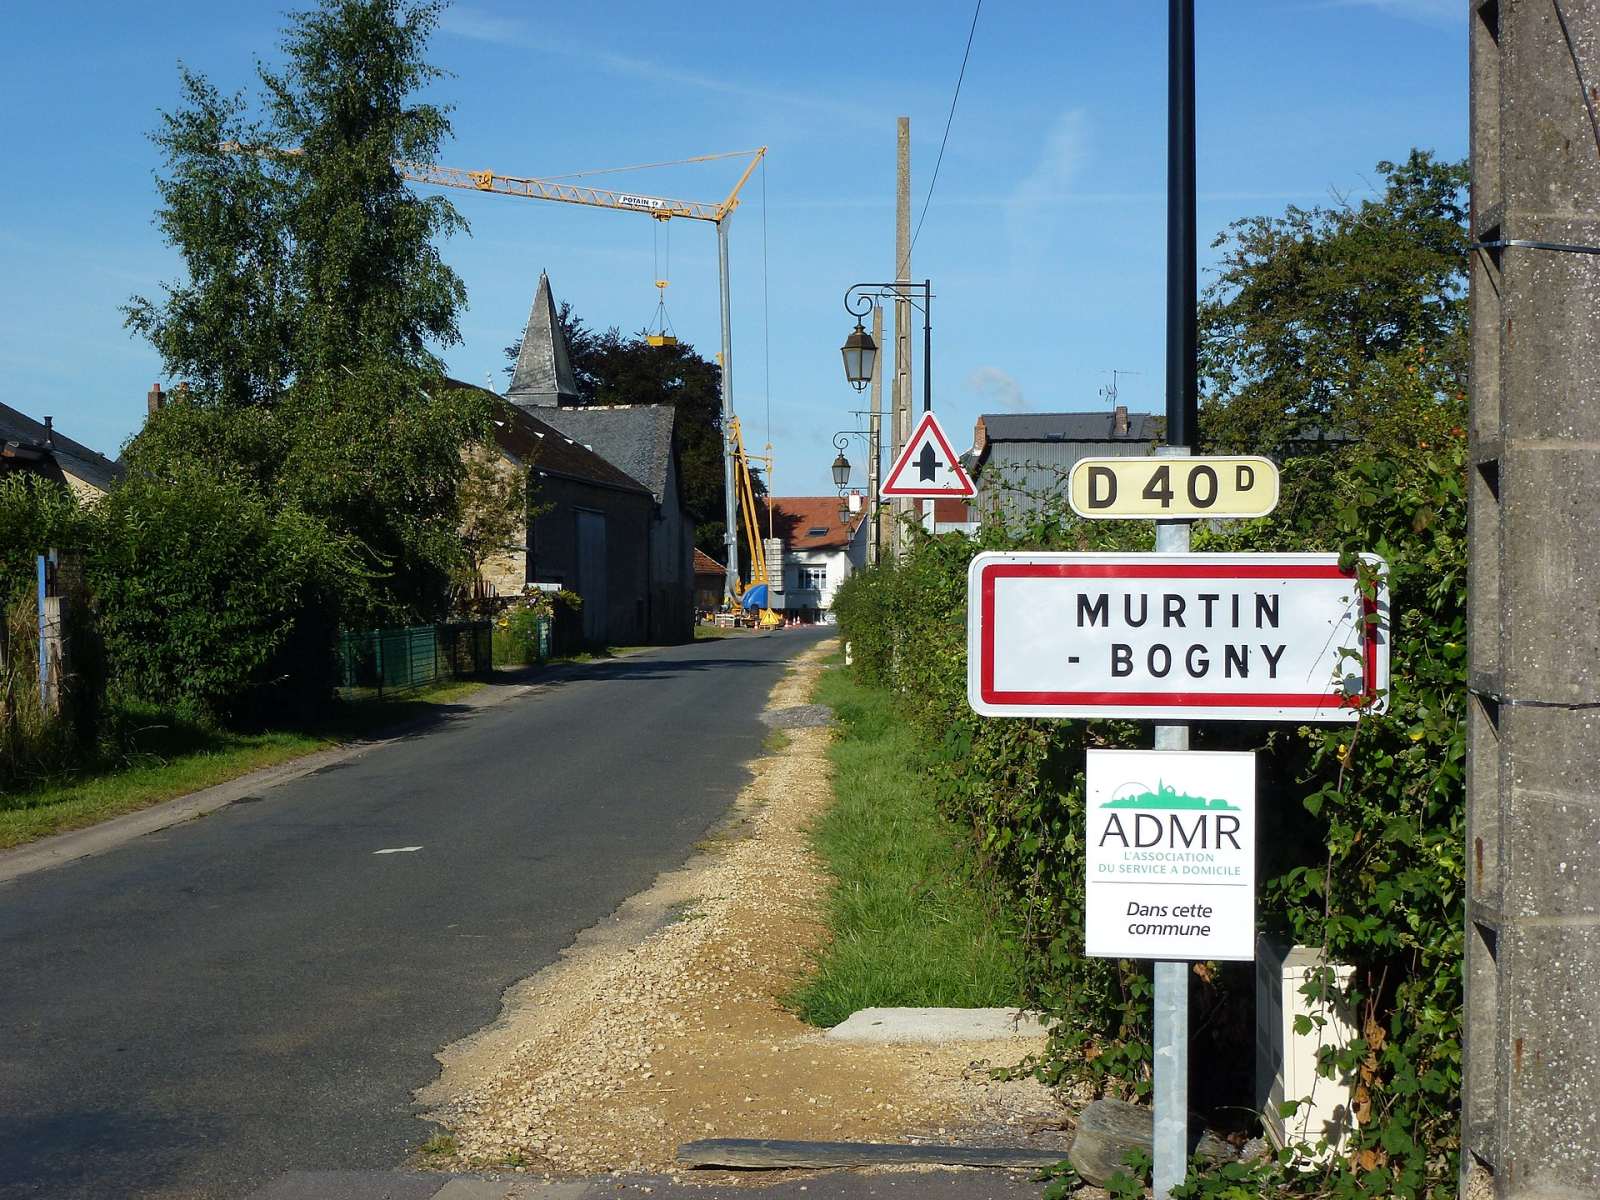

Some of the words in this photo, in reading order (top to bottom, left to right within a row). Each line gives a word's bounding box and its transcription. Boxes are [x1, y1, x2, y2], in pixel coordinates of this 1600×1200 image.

[622, 196, 649, 205] POTAIN
[1087, 466, 1118, 509] D
[1076, 593, 1280, 629] MURTIN
[1098, 813, 1242, 850] ADMR
[1124, 851, 1215, 863] L'ASSOCIATION
[1098, 863, 1115, 873] DU
[1119, 864, 1167, 874] SERVICE
[1182, 865, 1241, 876] DOMICILE
[1126, 902, 1169, 917] Dans
[1172, 904, 1213, 918] cette
[1128, 923, 1211, 937] commune
